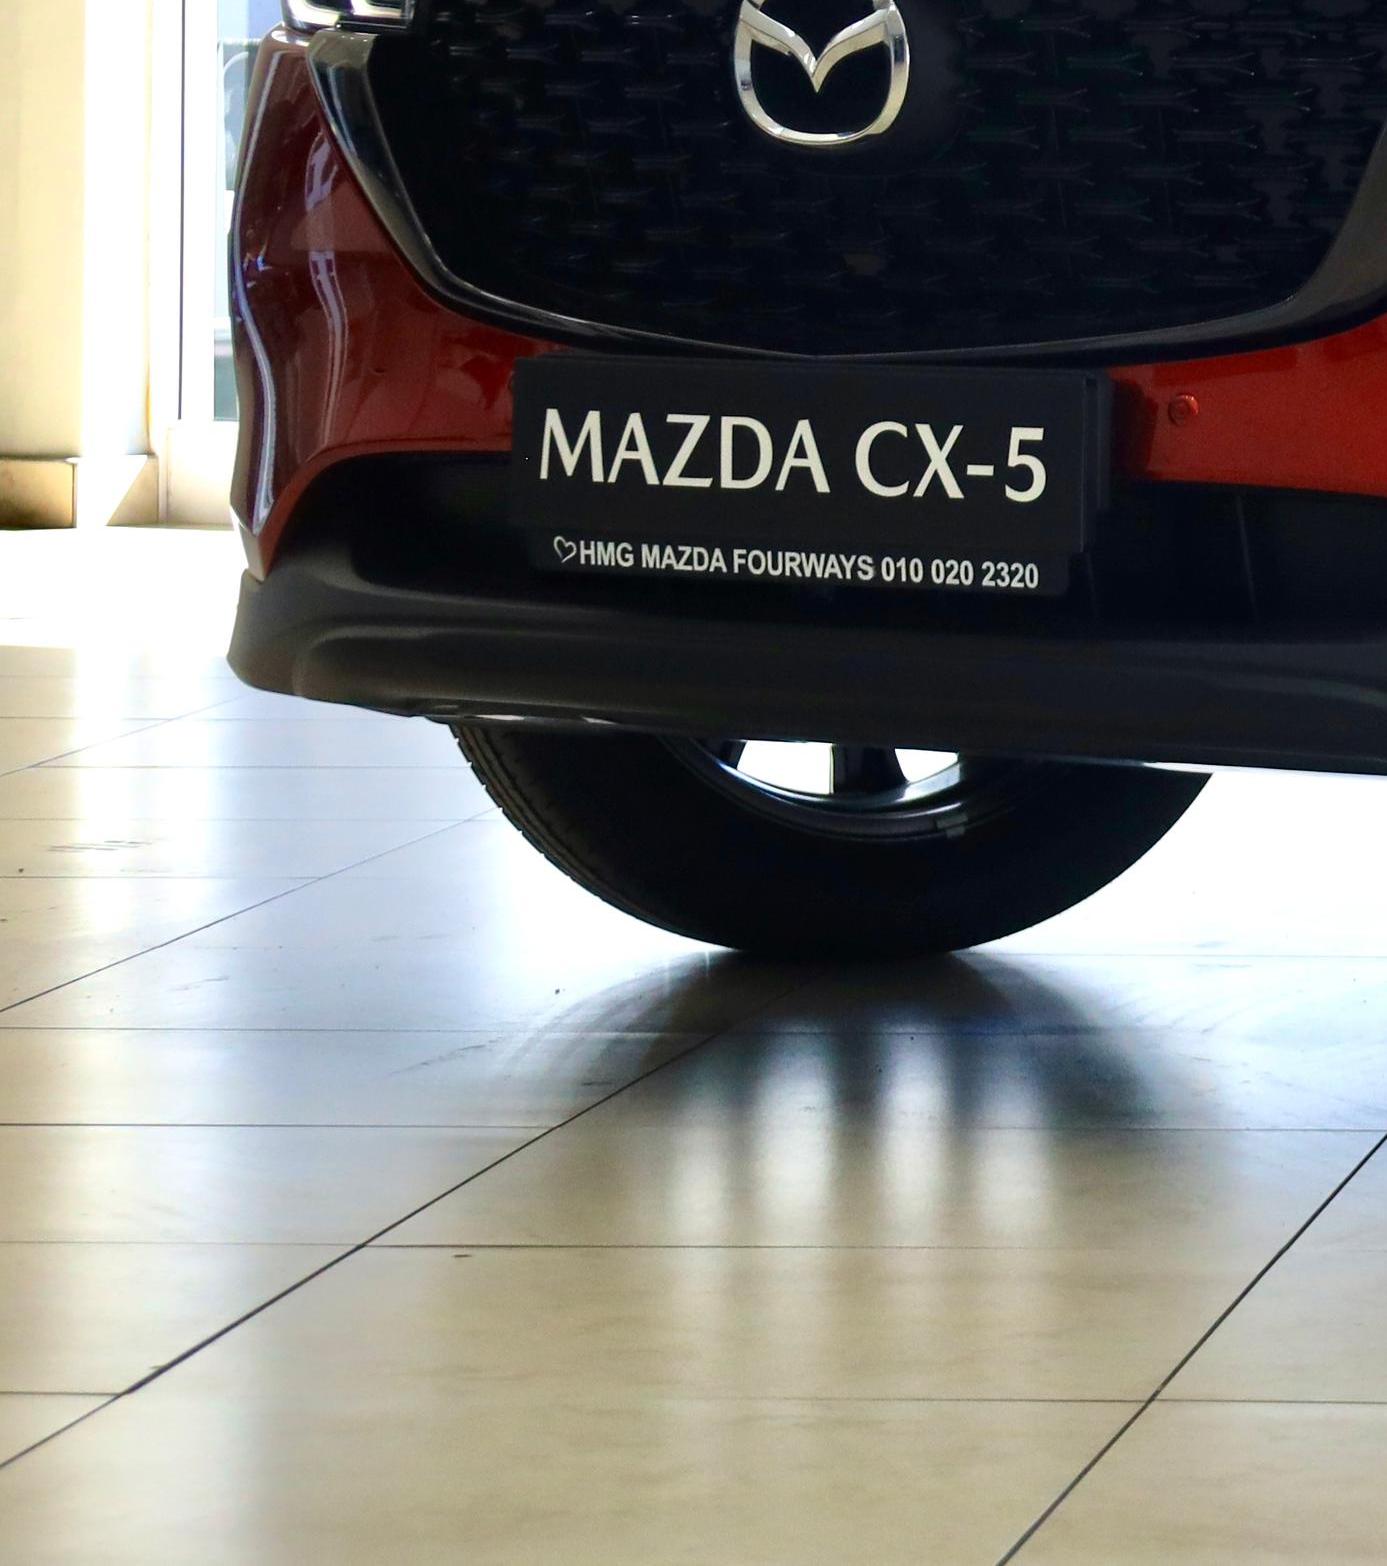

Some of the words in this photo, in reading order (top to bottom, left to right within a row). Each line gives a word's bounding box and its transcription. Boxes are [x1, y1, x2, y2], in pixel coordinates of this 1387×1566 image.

[540, 408, 831, 494] MAZDA
[855, 421, 1047, 503] CX-5
[579, 540, 634, 568] HMG
[641, 543, 728, 574] MAZDA
[733, 548, 875, 581] FOURWAYS
[881, 556, 924, 584] 010
[930, 558, 974, 586] 020
[981, 561, 1039, 589] 2320
